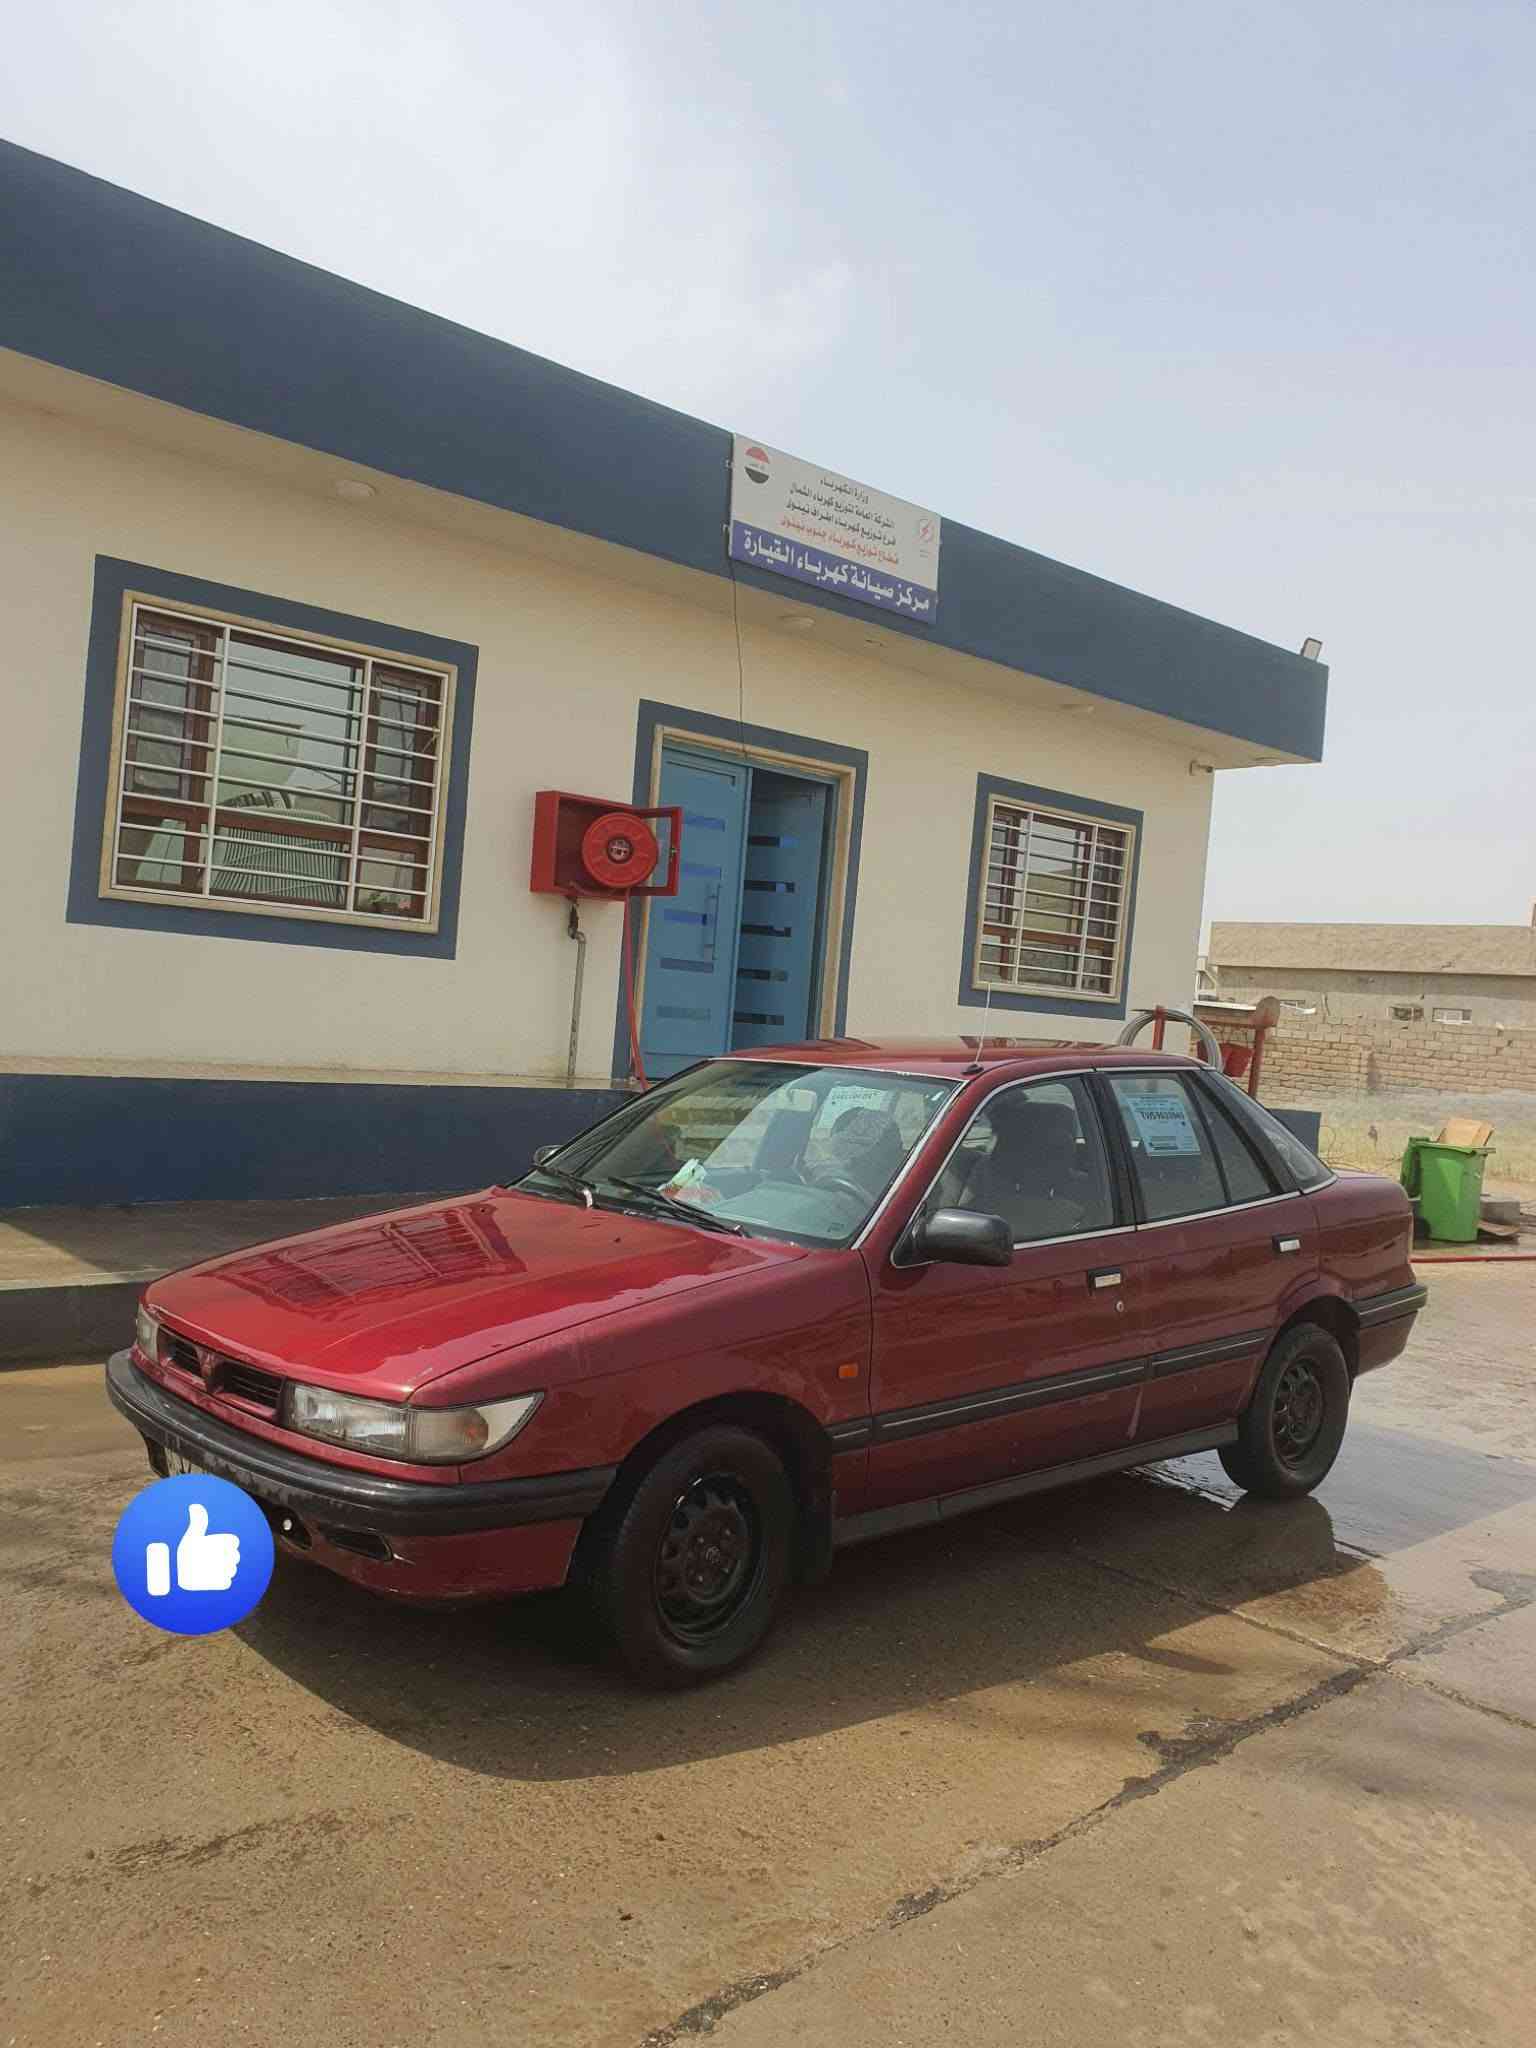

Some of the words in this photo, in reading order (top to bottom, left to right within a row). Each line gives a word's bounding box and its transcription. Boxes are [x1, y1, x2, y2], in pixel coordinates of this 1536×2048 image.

[744, 529, 794, 566] القيارة
[797, 551, 848, 585] كهرباء
[850, 564, 894, 600] صيانة
[896, 583, 929, 612] مركز
